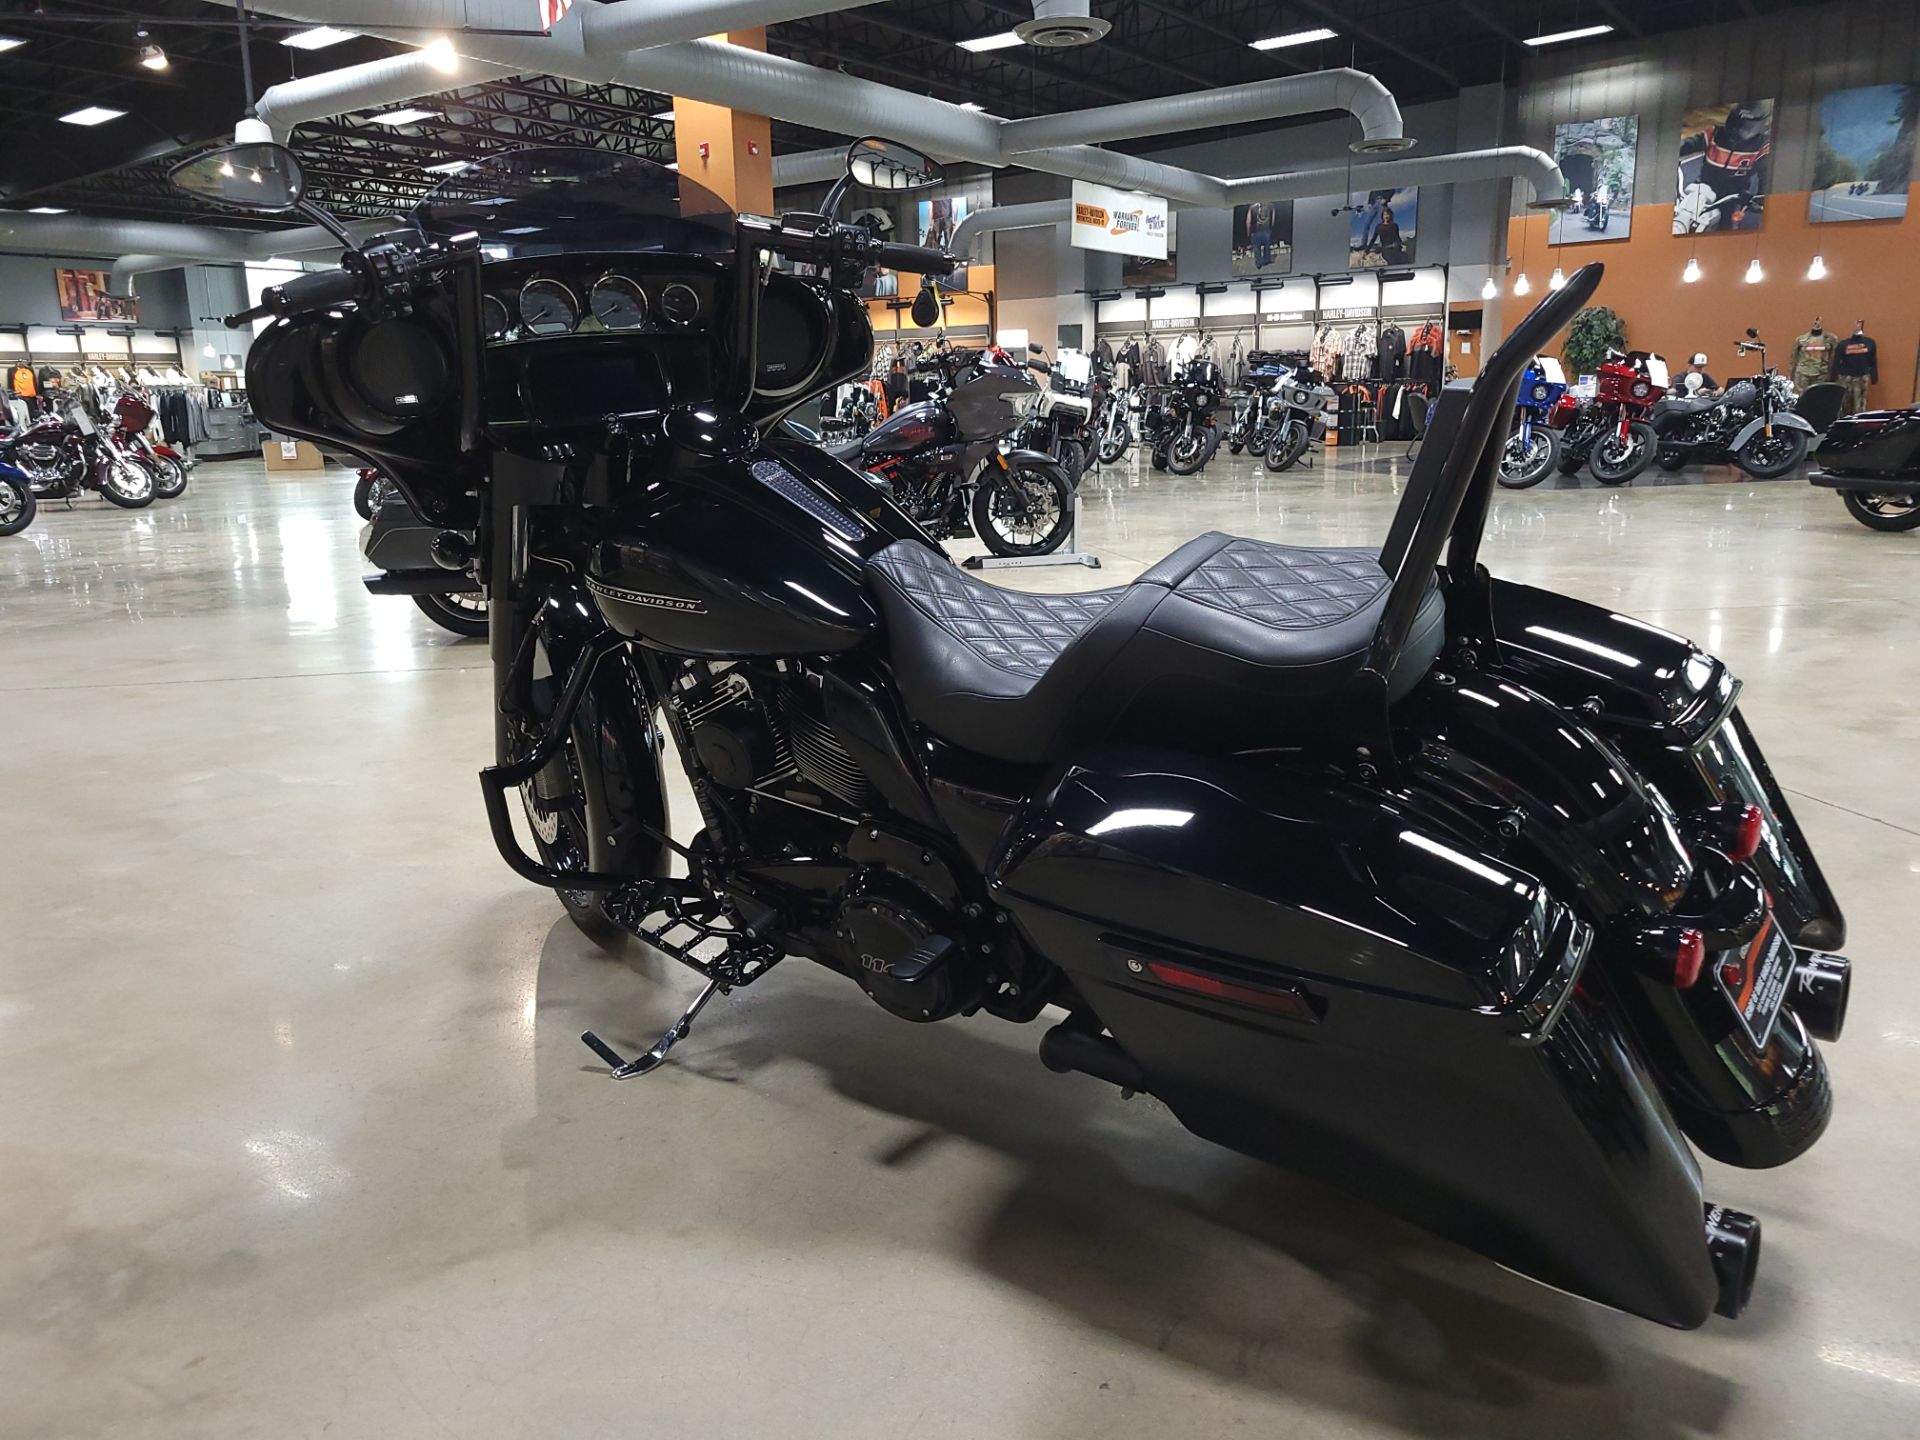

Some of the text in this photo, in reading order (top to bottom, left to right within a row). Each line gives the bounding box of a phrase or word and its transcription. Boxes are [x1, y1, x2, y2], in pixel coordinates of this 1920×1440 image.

[1113, 211, 1138, 222] WARRANTY
[1322, 308, 1372, 319] HARLEY-DAVIDSON
[1152, 318, 1194, 329] HARLEY-DAVIDSON
[586, 580, 696, 609] HARLEY-DAVIDSON
